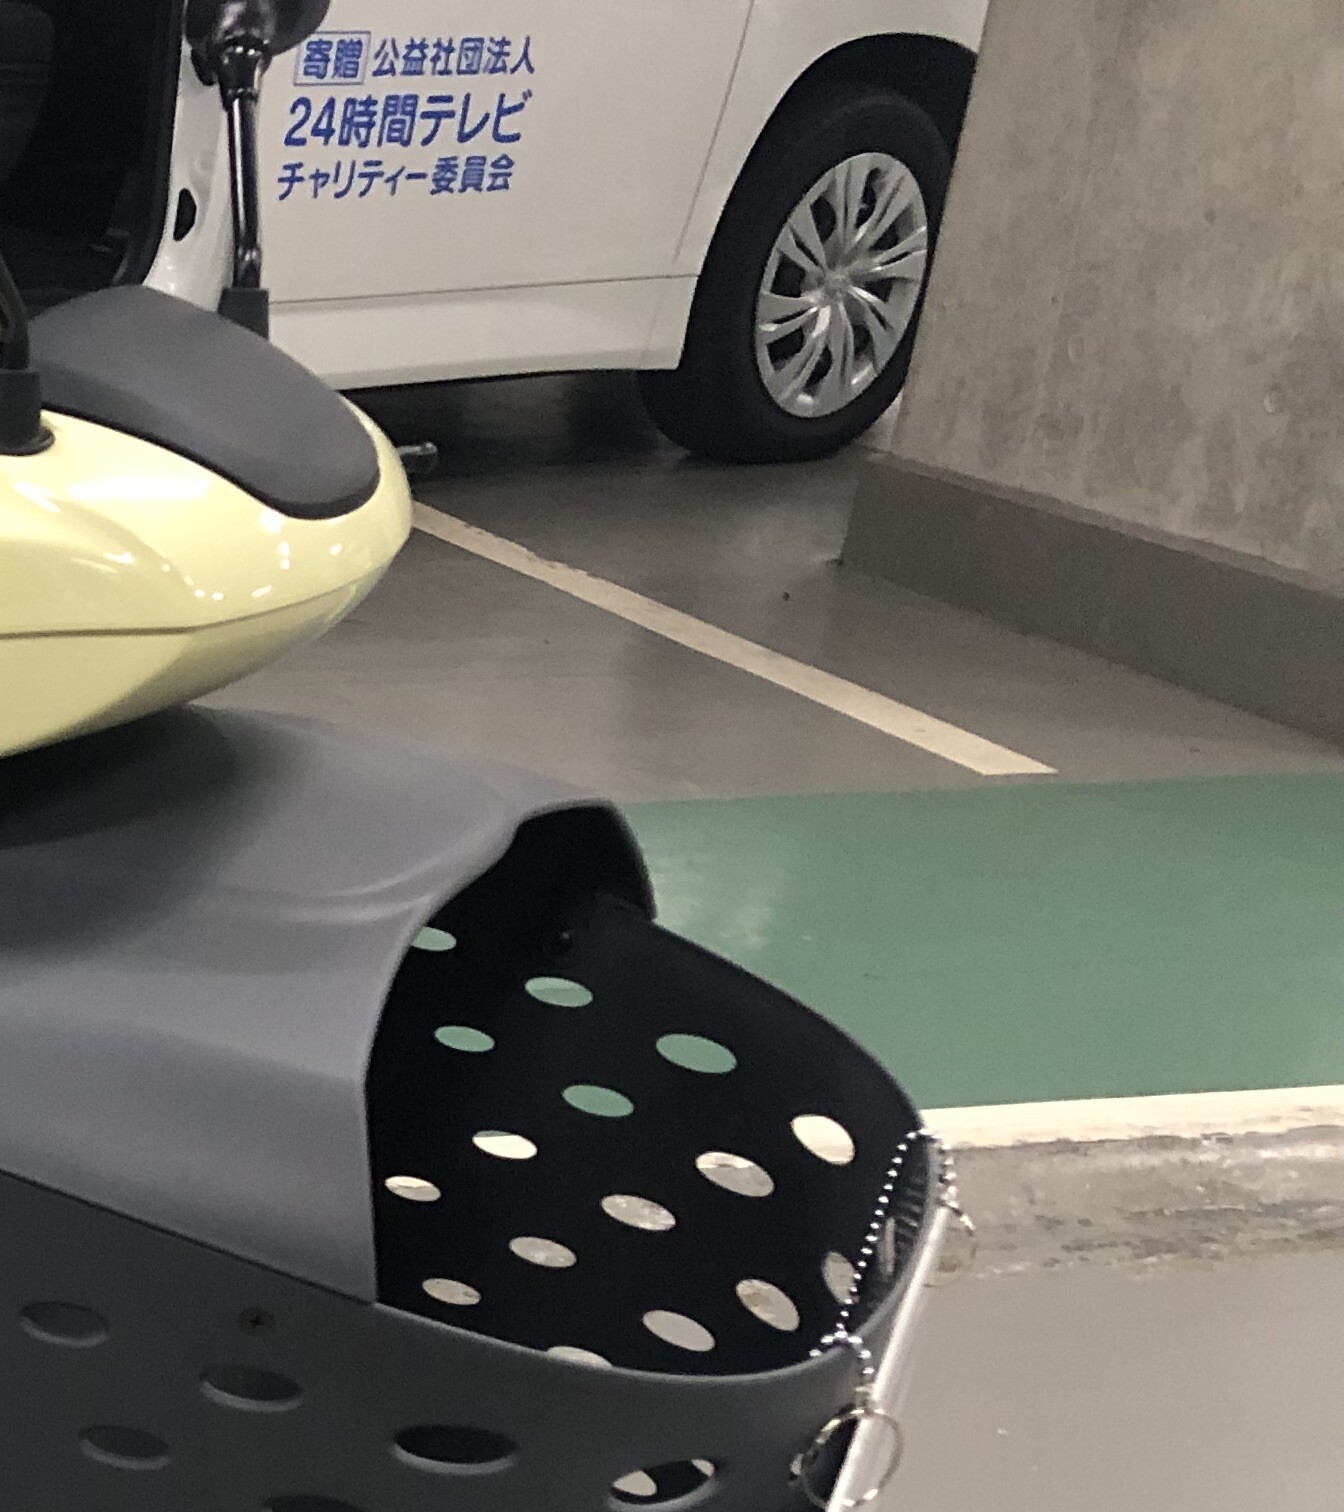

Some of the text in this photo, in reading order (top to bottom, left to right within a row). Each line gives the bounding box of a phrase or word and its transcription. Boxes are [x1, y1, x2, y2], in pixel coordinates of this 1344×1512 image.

[302, 36, 535, 79] 寄贈 公益社団法人
[284, 90, 533, 147] 24時間テレビ
[278, 154, 515, 200] チャリティー委員会
